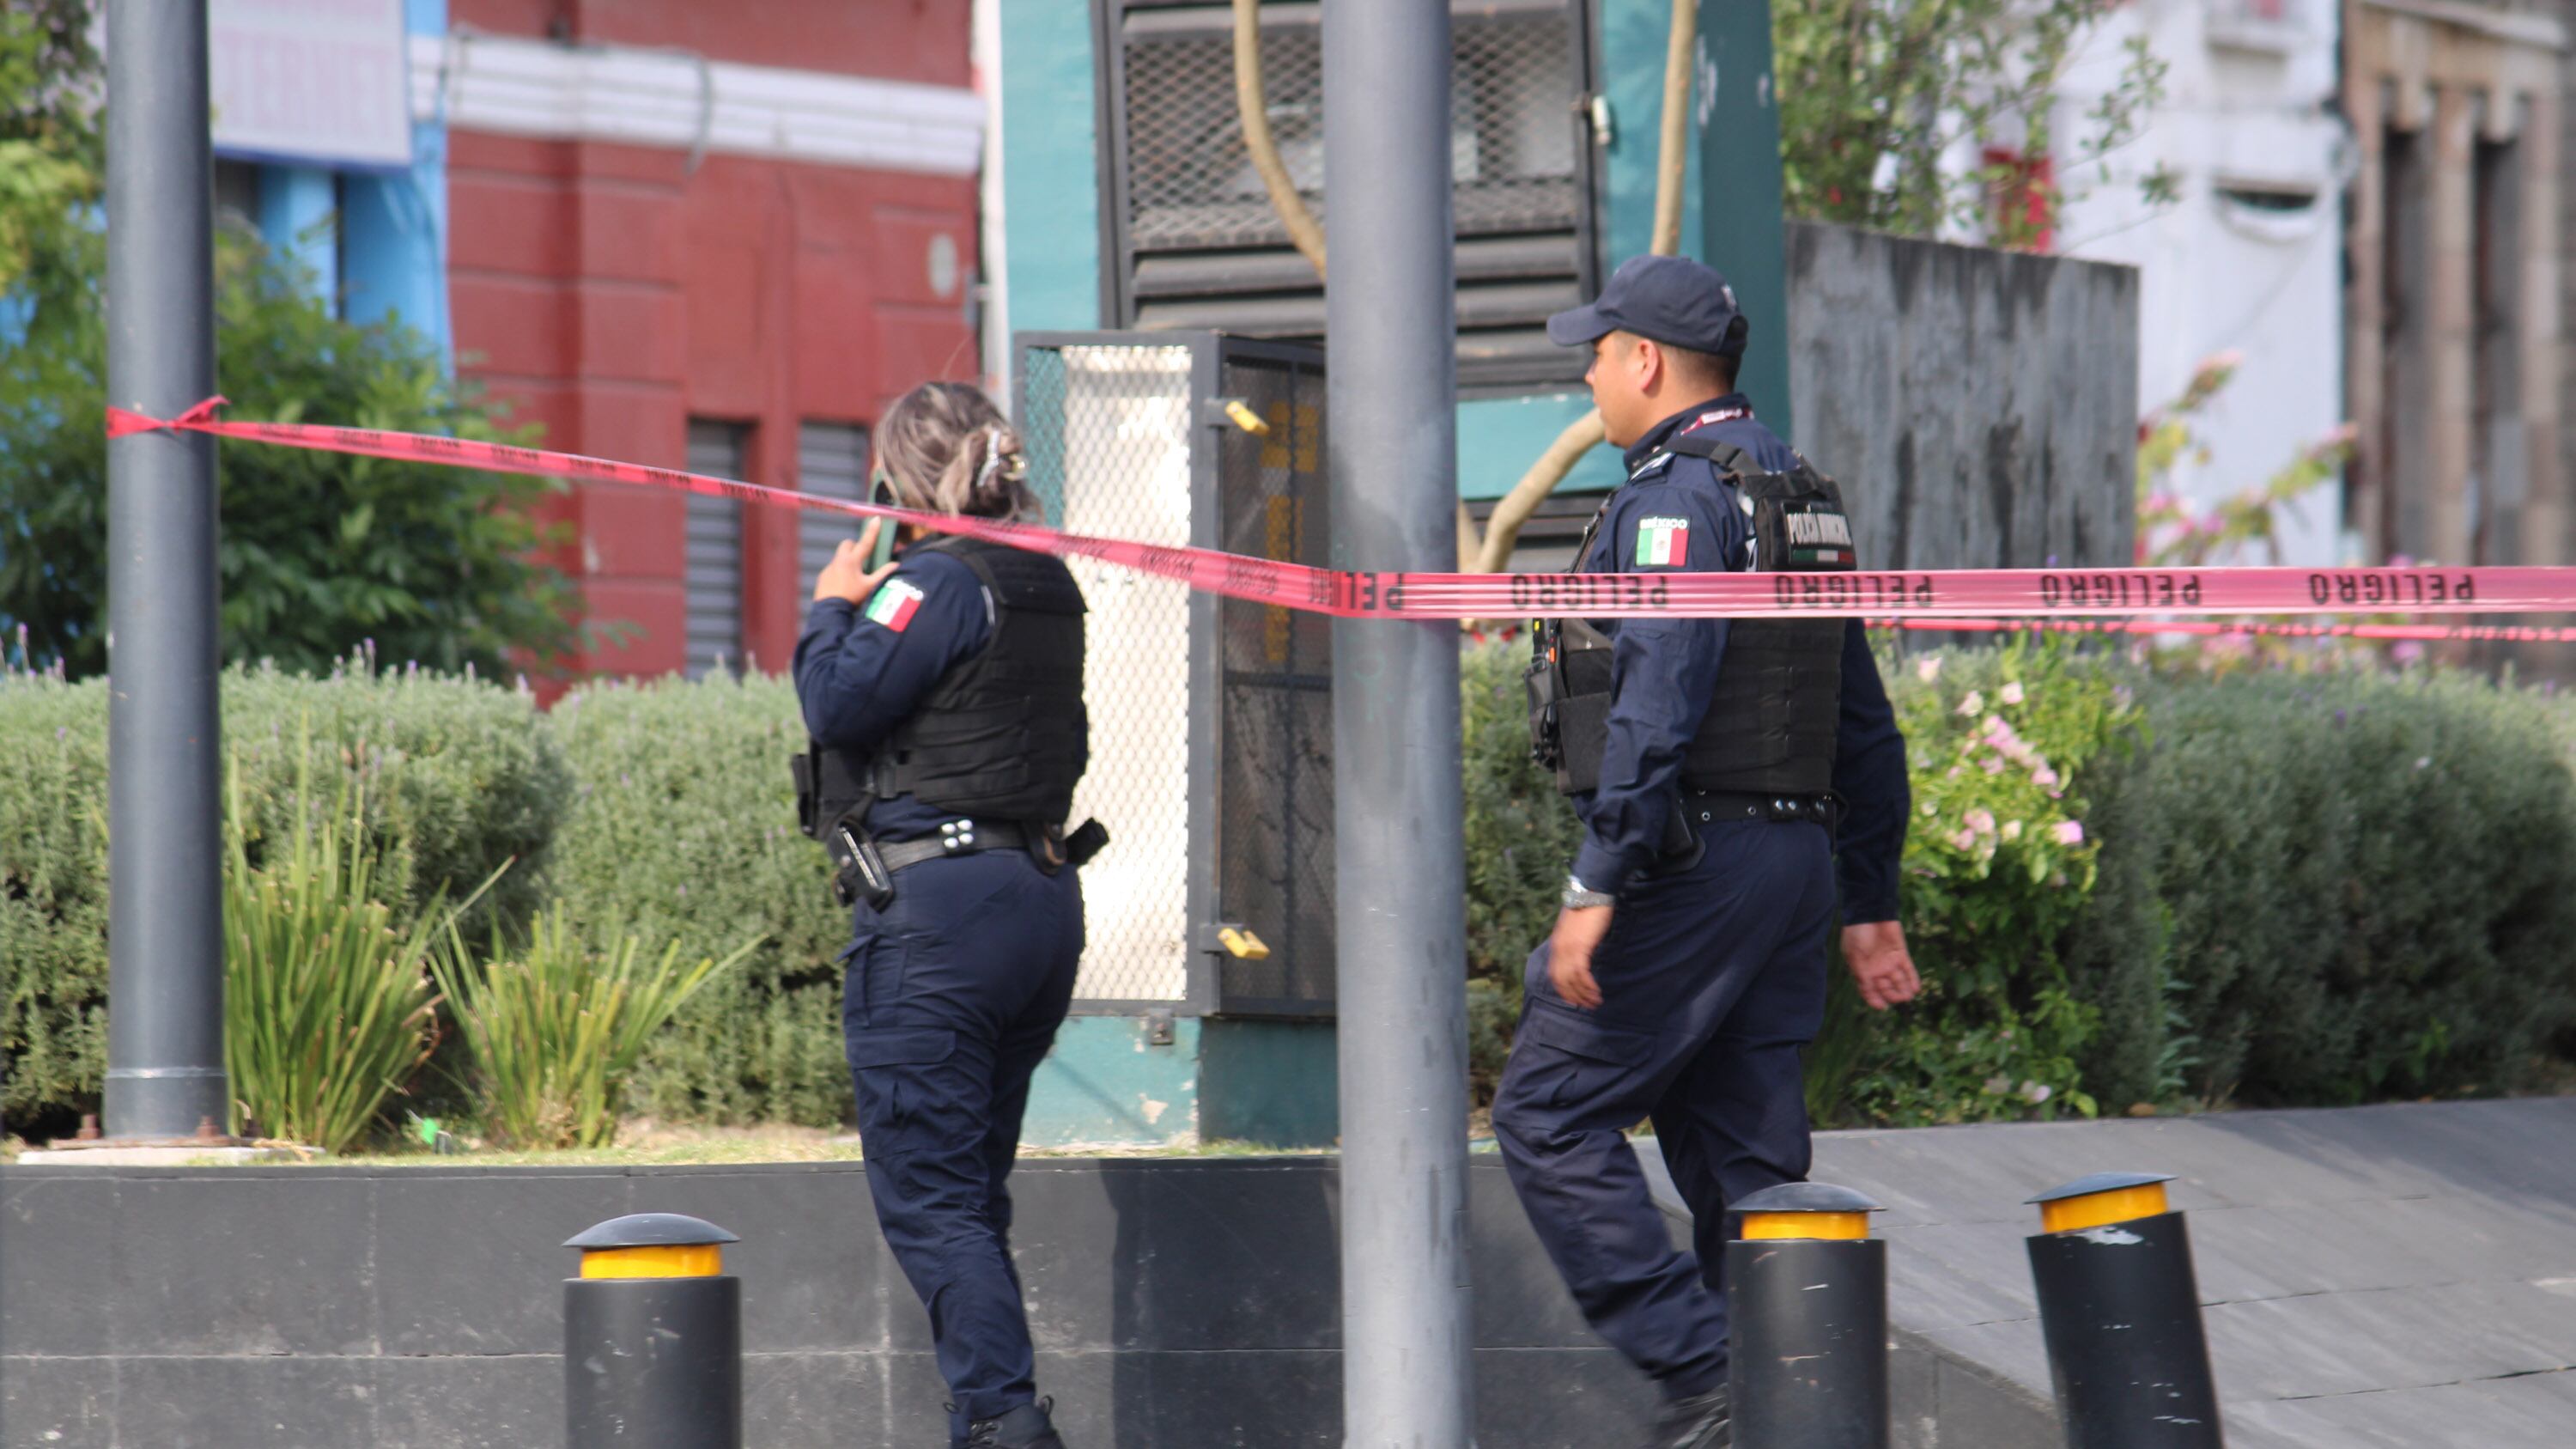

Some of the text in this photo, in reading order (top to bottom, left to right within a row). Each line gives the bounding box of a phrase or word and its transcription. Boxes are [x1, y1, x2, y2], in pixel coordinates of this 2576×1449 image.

[1511, 575, 1668, 609] PELIGRO
[1775, 575, 1931, 608] PELIGRO
[2040, 574, 2202, 606] PELIGRO
[2304, 573, 2475, 605] PELIGRO
